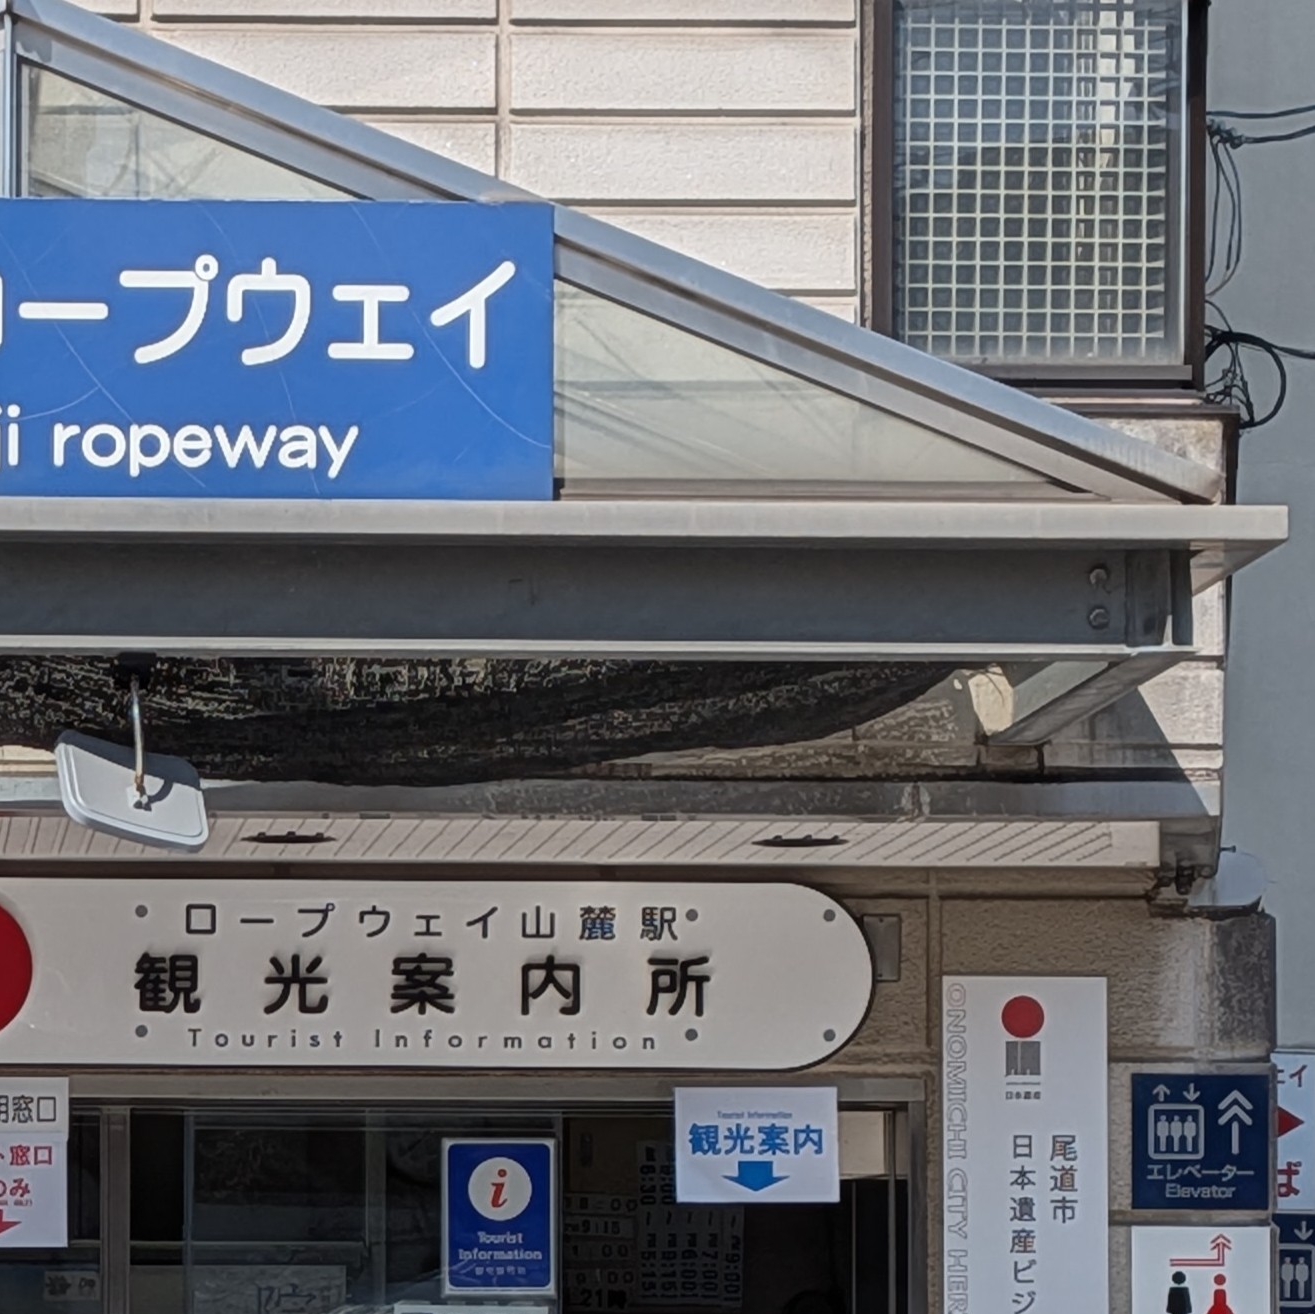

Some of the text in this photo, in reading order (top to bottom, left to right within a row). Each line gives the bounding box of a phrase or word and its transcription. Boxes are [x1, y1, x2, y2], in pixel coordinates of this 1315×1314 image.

[52, 420, 360, 479] ropeway
[185, 903, 682, 943] ロープウェイ山麓駅
[134, 950, 712, 1018] 観光案内所
[187, 1028, 661, 1051] Tourist Information
[946, 983, 968, 1160] ONOMICHI
[688, 1123, 824, 1157] 観光案内
[1049, 1134, 1078, 1224] 尾道市
[1146, 1163, 1255, 1181] エレベーター
[946, 1167, 968, 1240] CITY
[1165, 1184, 1236, 1198] Elevator
[458, 1248, 543, 1260] Information
[477, 1231, 523, 1243] Tourist
